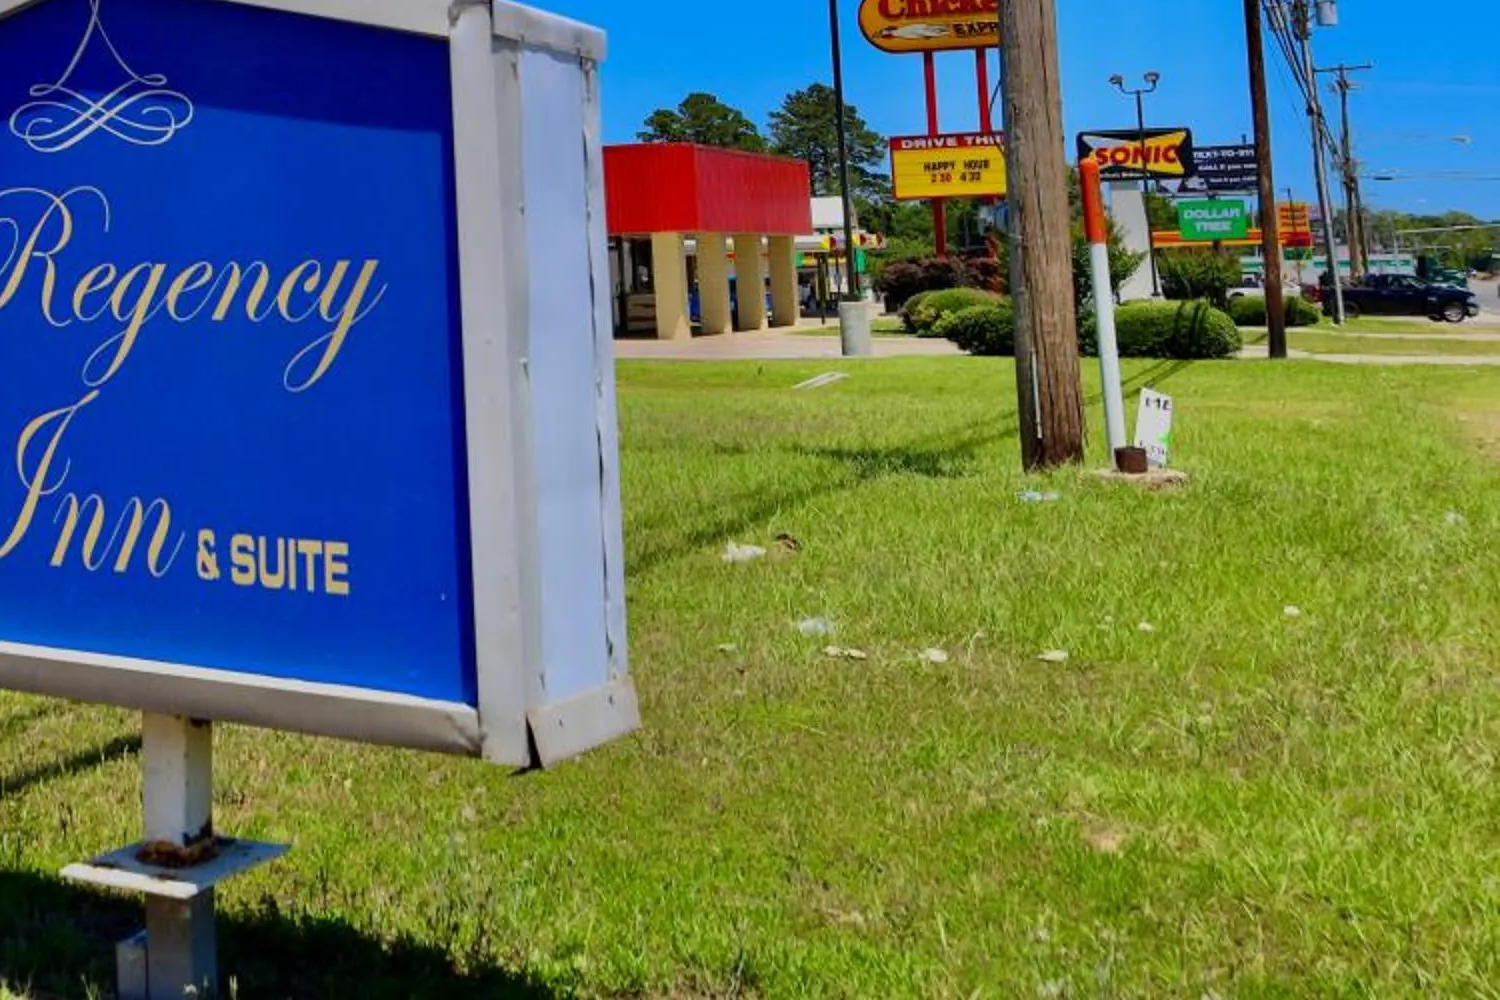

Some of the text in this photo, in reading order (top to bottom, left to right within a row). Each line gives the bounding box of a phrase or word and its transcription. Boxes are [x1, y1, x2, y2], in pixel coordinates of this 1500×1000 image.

[952, 21, 999, 38] EXPR
[901, 137, 958, 149] DRIVE
[1095, 144, 1178, 165] SONIC
[923, 159, 990, 171] HAPPY HOUR
[1183, 207, 1241, 219] DOLLAR
[196, 528, 220, 580] &
[230, 534, 350, 595] SUITE
